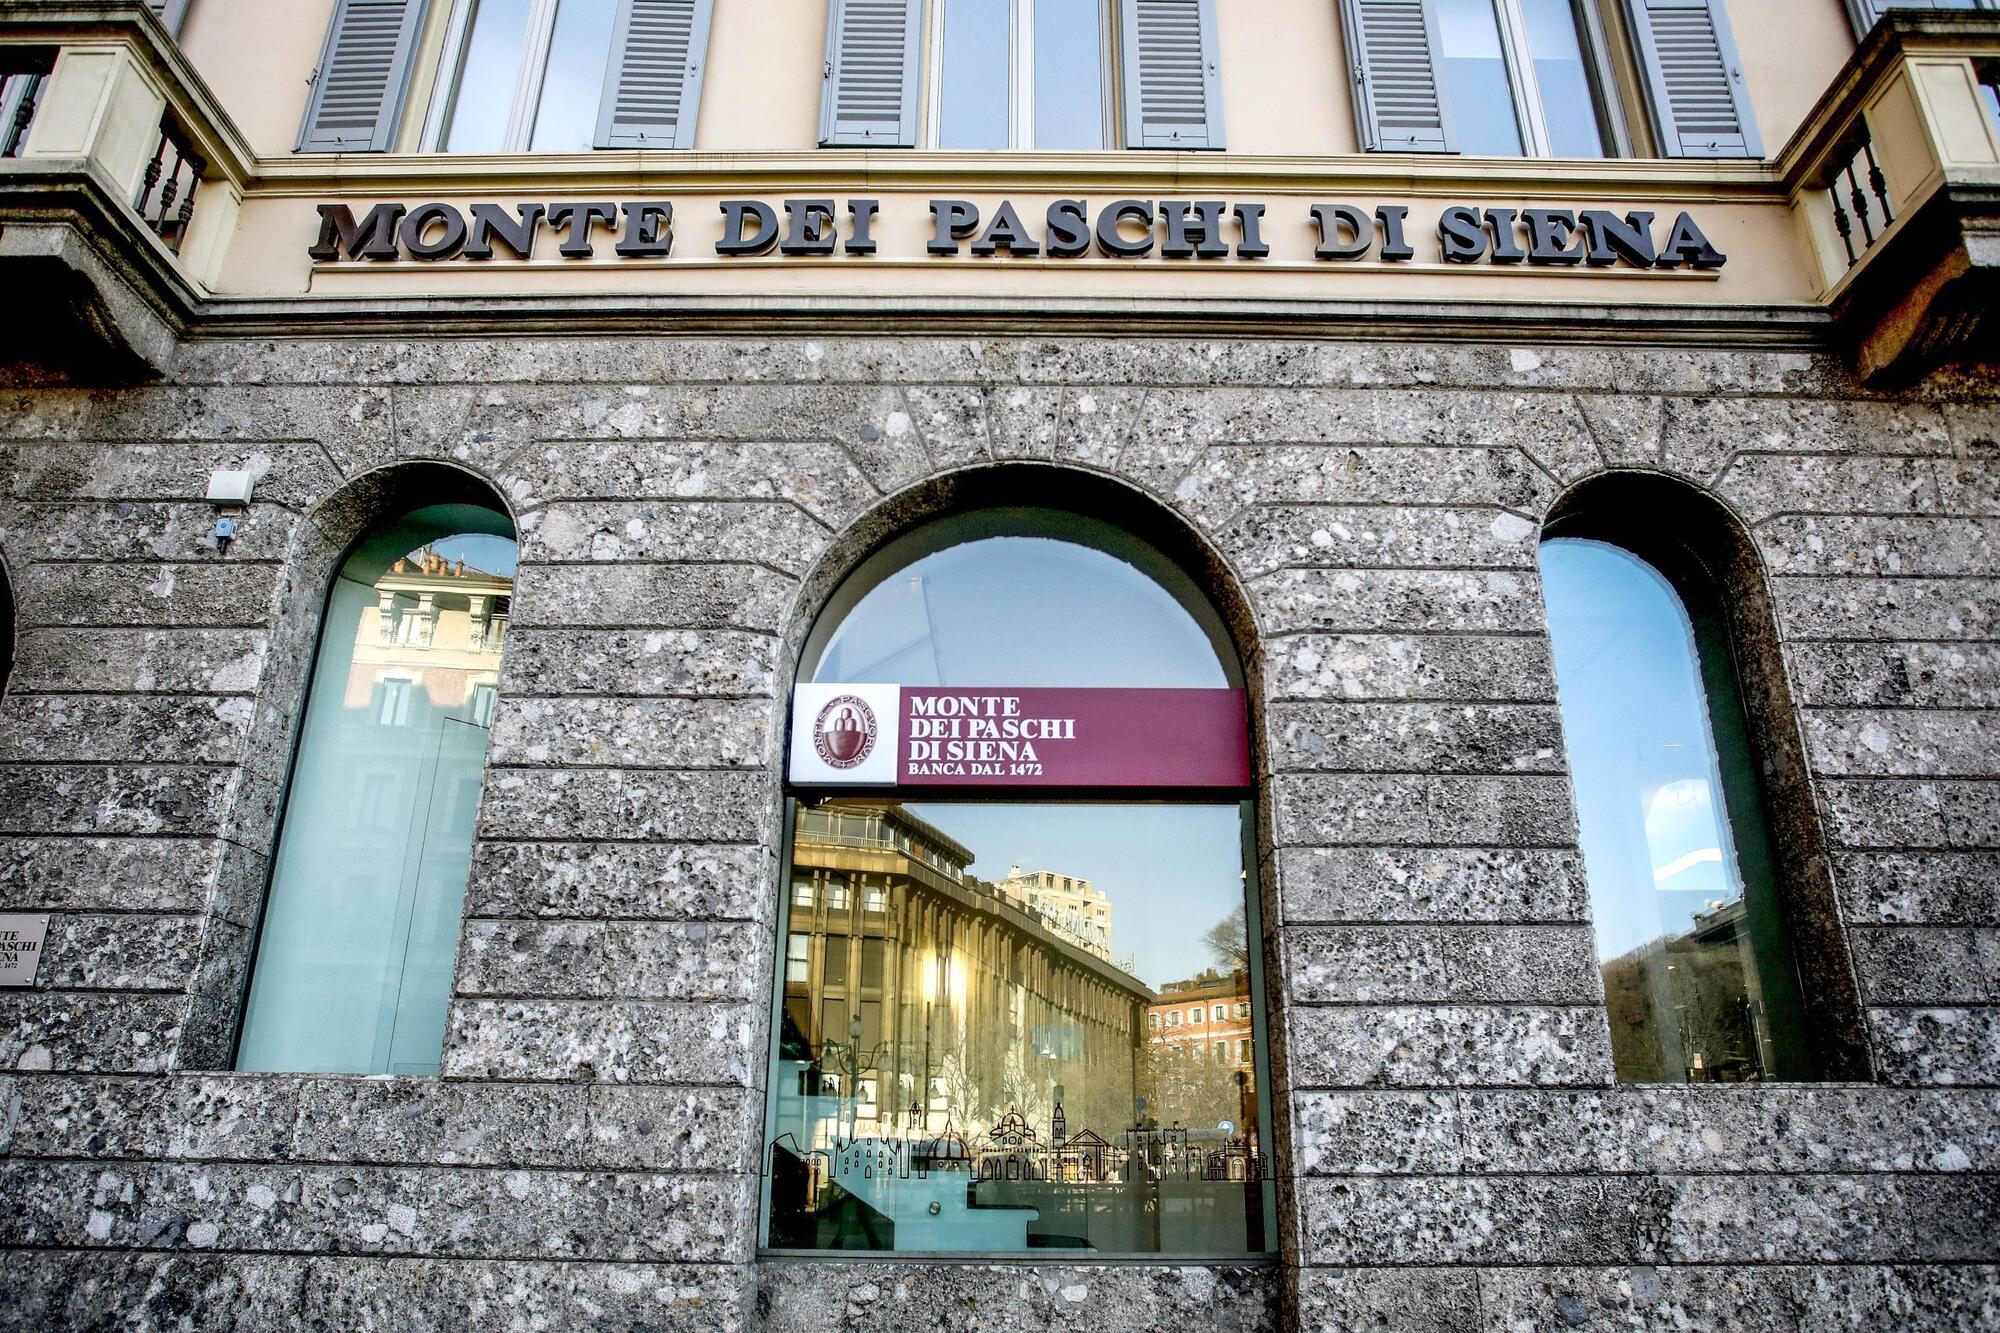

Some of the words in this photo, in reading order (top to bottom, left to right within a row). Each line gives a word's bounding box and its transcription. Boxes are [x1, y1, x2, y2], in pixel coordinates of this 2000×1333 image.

[308, 201, 673, 260] MONTE
[715, 199, 879, 256] DEI
[927, 199, 1269, 259] PASCHI
[1310, 204, 1414, 261] DI
[1438, 206, 1727, 269] SIENA
[909, 696, 1021, 717] MONTE
[909, 718, 962, 739] DEI
[967, 718, 1076, 739] PASCHI
[908, 740, 942, 761] DI
[946, 740, 1039, 761] SIENA
[908, 763, 966, 775] BANCA
[970, 763, 1005, 775] DAL
[1009, 763, 1043, 776] 1472
[0, 941, 38, 951] ASCHI
